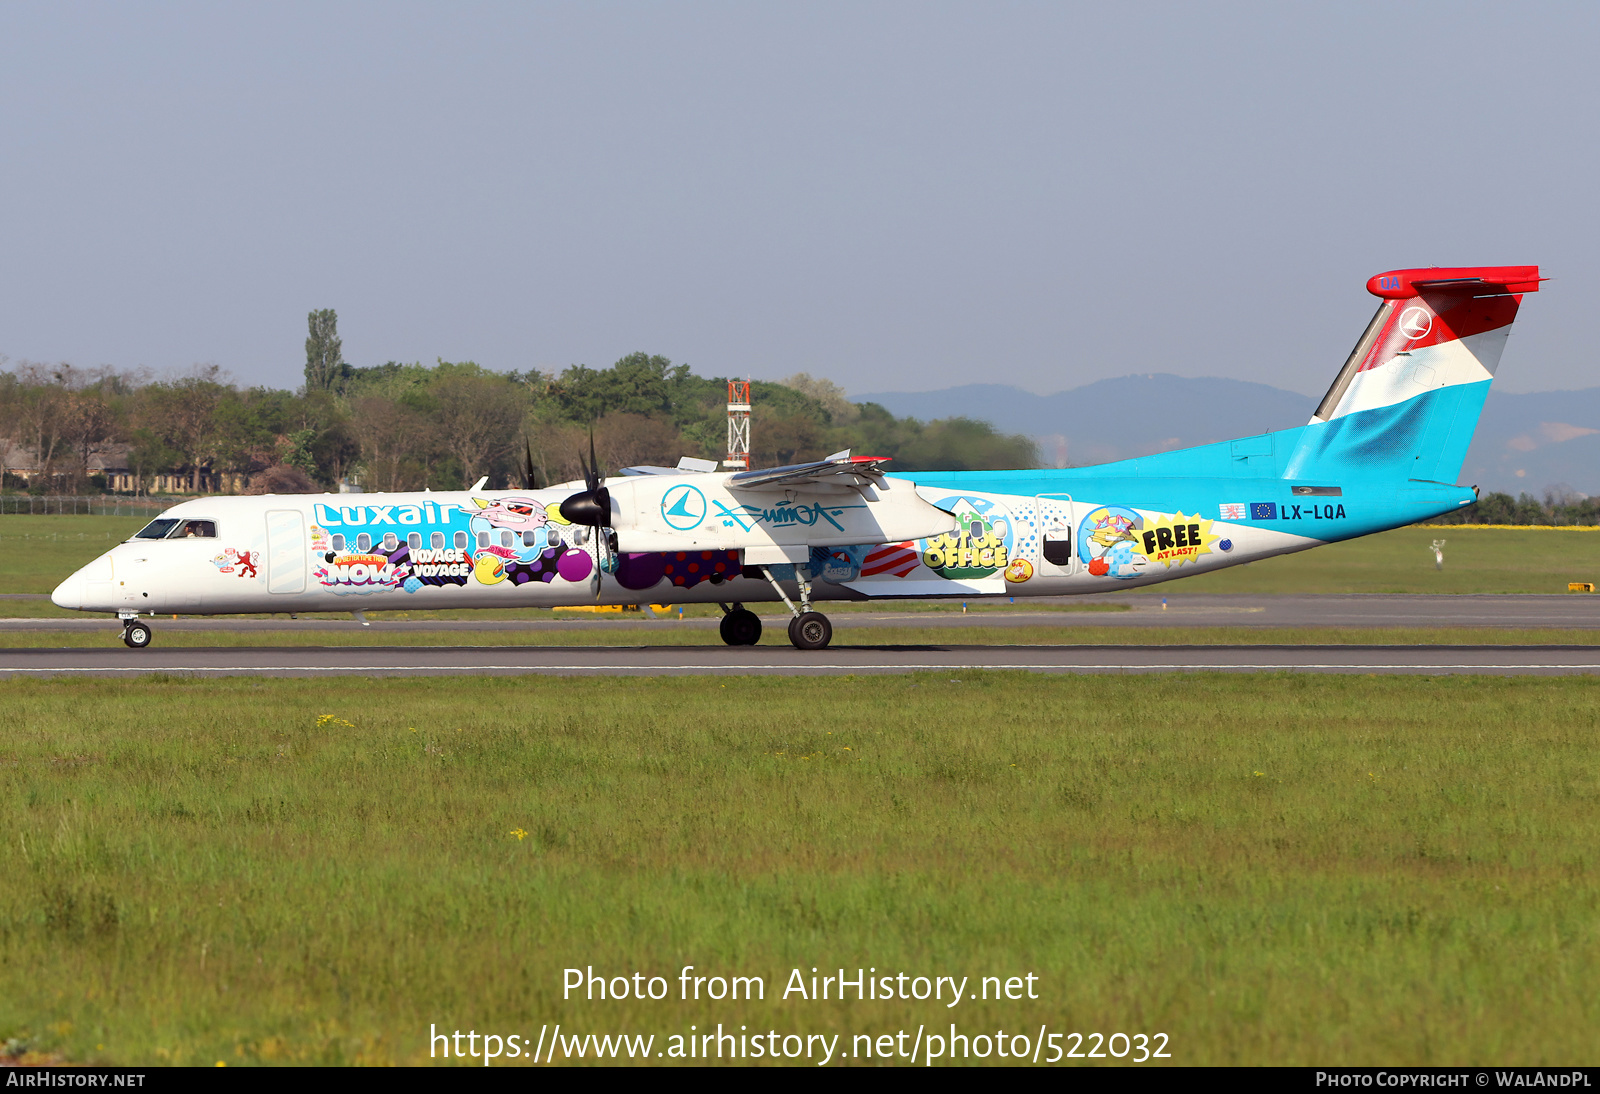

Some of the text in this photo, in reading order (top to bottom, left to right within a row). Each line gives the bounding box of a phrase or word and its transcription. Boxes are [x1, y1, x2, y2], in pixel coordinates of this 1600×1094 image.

[1381, 276, 1400, 290] QA
[314, 501, 459, 526] Luxair
[1281, 504, 1346, 520] LX-LQA
[926, 531, 1003, 549] OUT OF
[1142, 524, 1202, 554] FREE
[343, 554, 360, 562] BETTER
[373, 555, 387, 563] THAN
[409, 549, 465, 563] VOYAGE
[923, 547, 1008, 569] OFFICE
[1157, 547, 1198, 560] AT LAST!
[327, 563, 396, 582] NOW
[413, 564, 470, 577] VOYAGE
[823, 563, 852, 579] Easy
